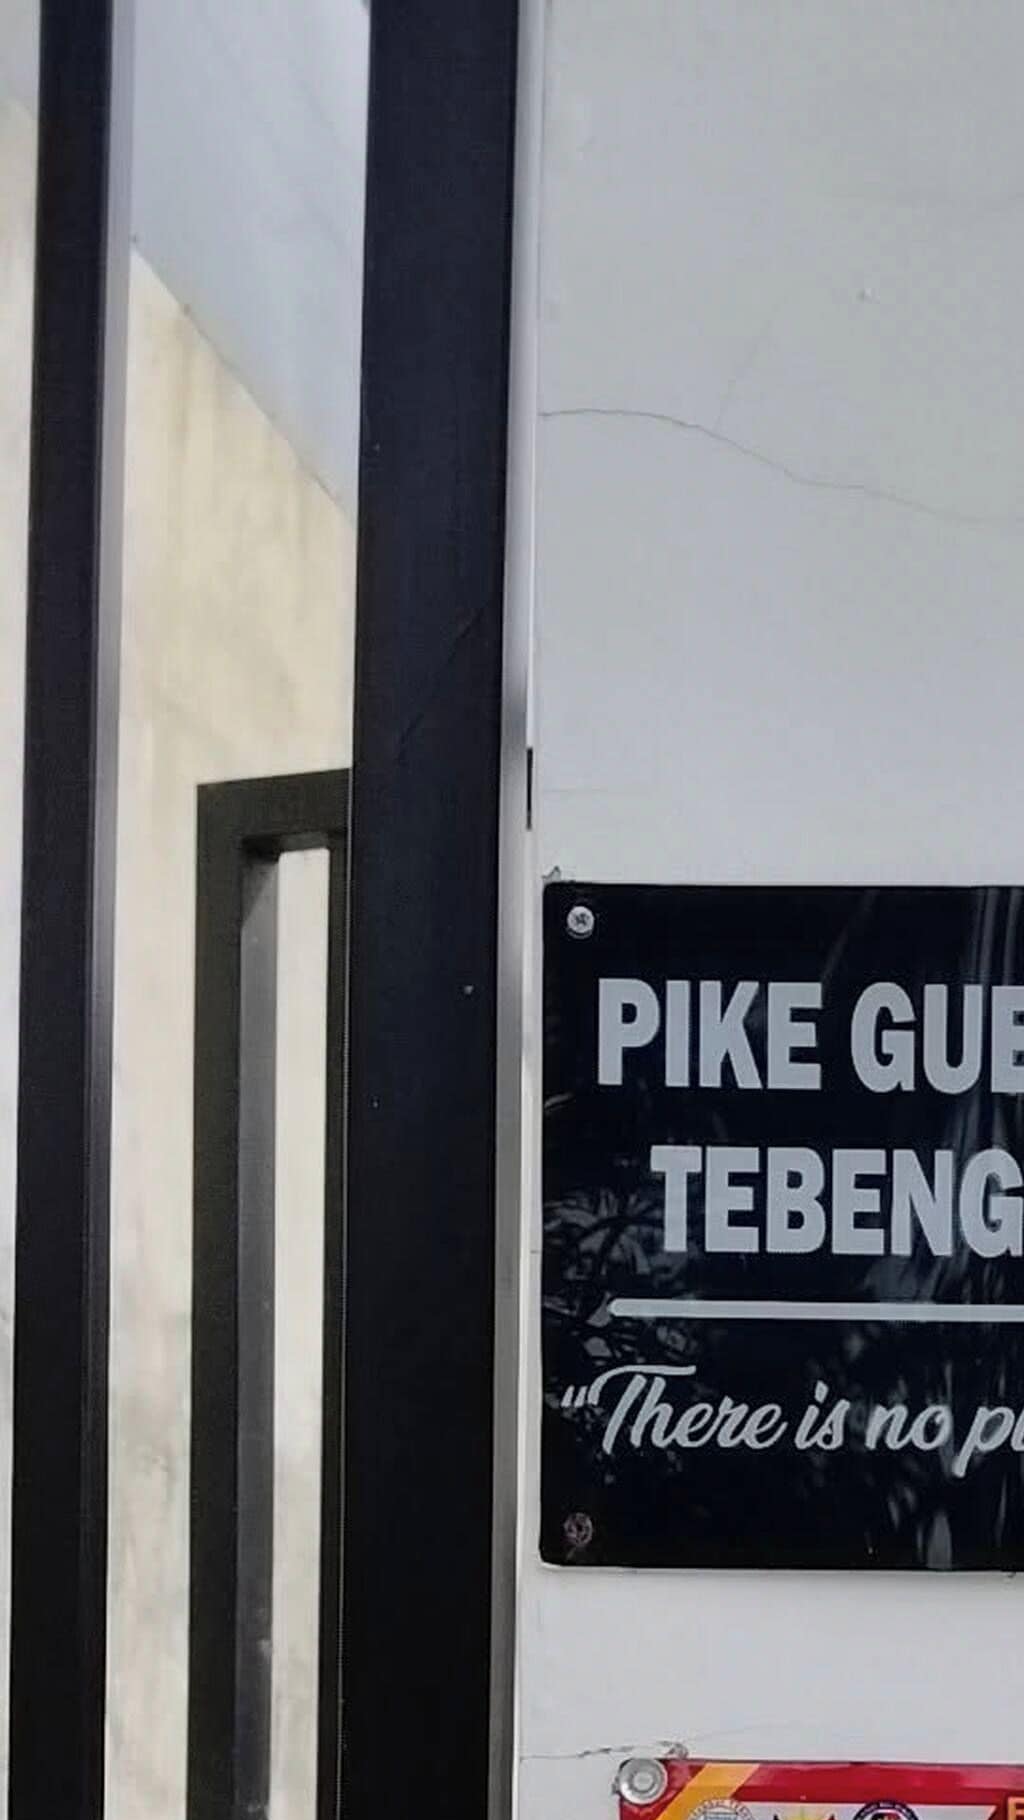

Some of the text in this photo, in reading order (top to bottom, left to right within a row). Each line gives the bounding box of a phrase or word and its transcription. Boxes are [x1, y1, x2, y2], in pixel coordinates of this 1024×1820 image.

[597, 978, 822, 1090] PIKE
[560, 1364, 788, 1457] "There
[793, 1381, 846, 1452] is
[865, 1402, 952, 1453] no
